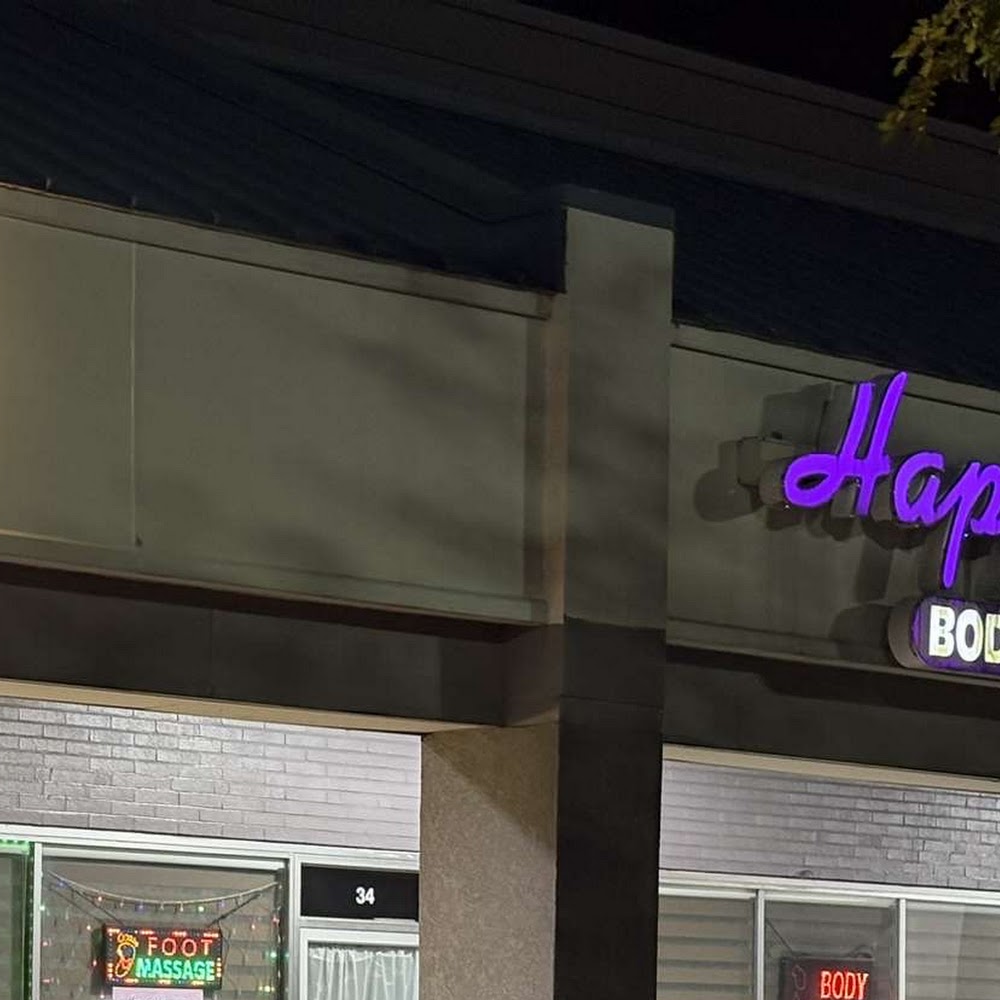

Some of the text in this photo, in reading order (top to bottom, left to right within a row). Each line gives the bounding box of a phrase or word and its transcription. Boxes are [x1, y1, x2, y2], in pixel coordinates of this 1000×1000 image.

[355, 886, 375, 905] 34
[148, 936, 214, 957] FOOT
[135, 957, 215, 981] MASSAGE
[820, 970, 869, 1000] BODY
